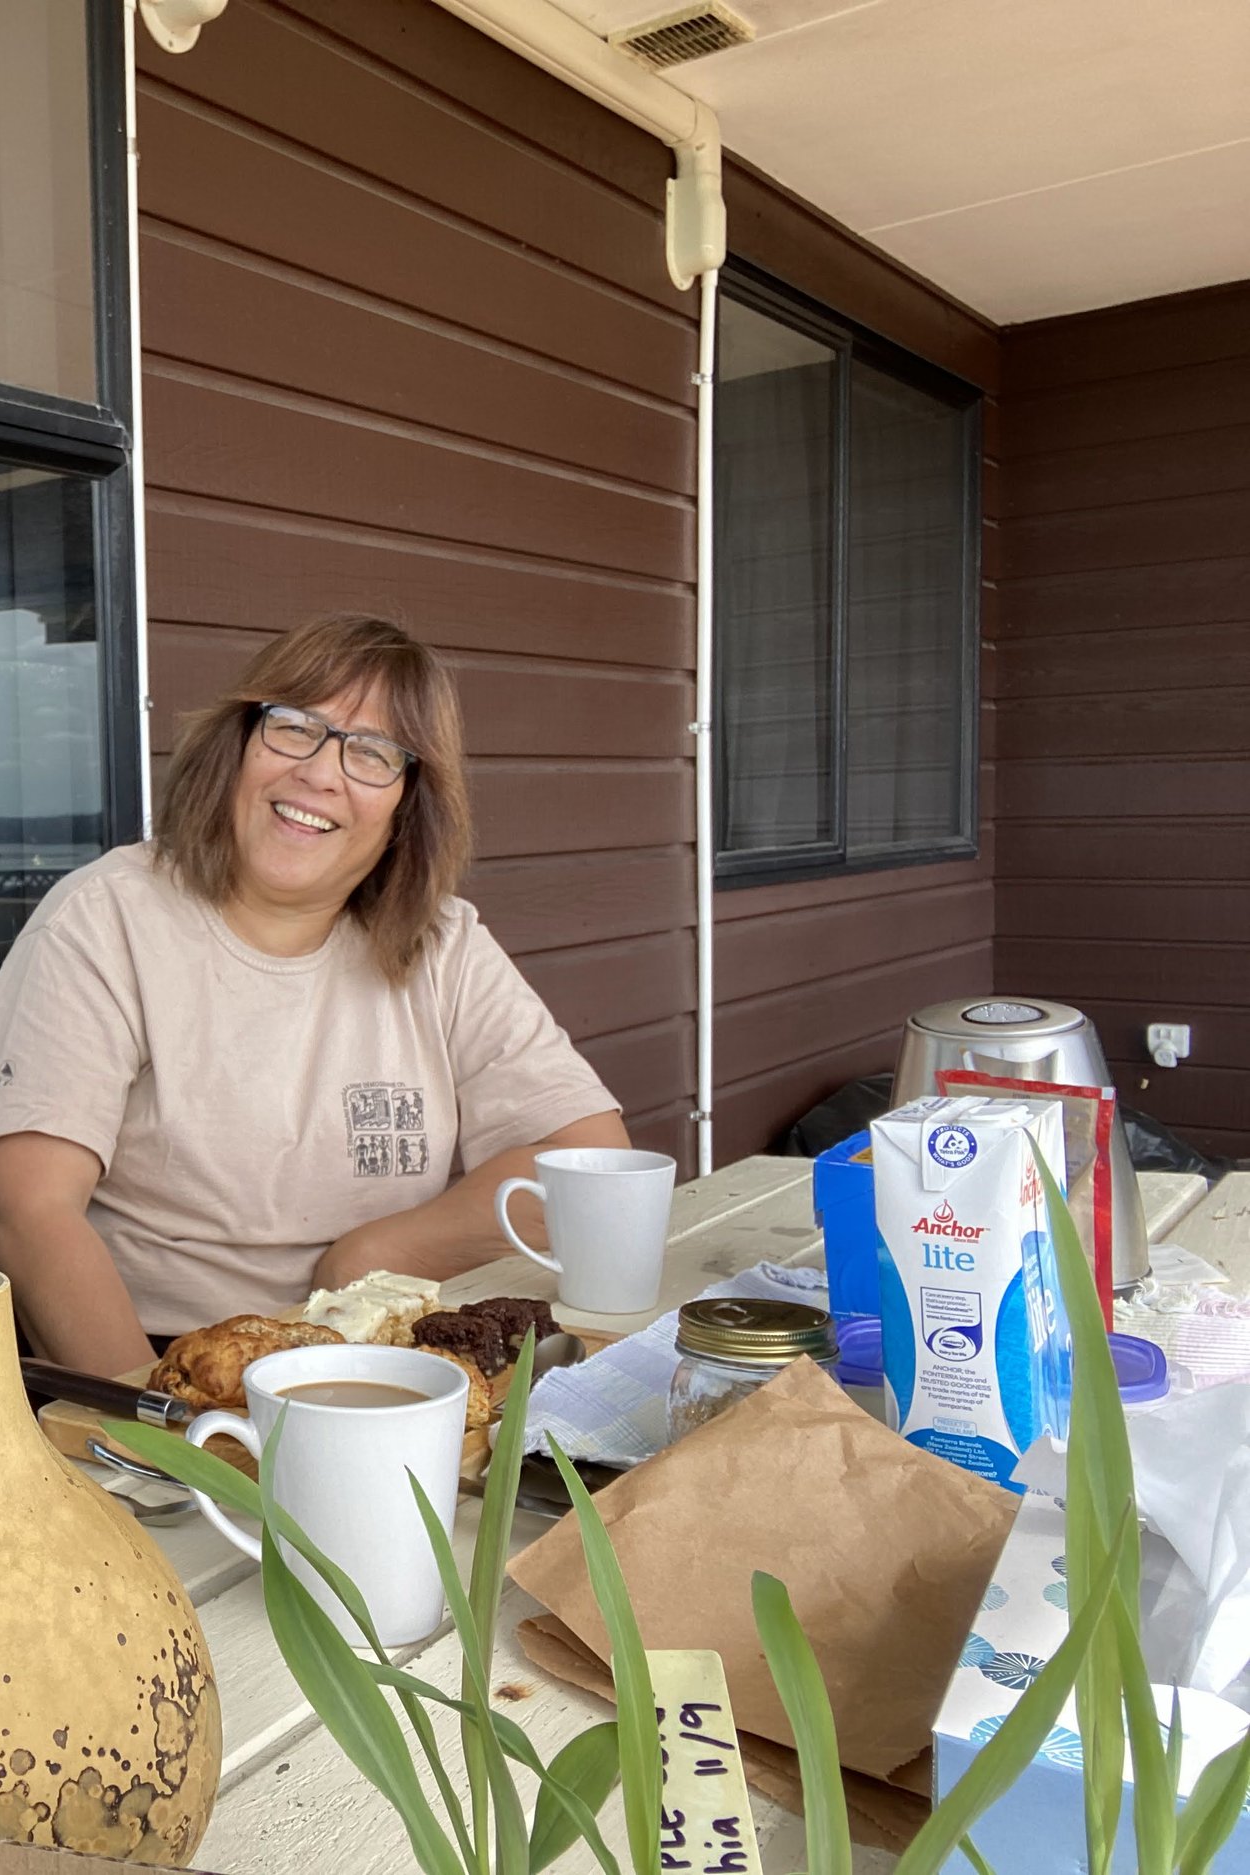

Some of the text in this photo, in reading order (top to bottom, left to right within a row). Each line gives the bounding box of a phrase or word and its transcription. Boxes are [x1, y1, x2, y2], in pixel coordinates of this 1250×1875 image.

[936, 1126, 970, 1136] PROTECTS
[933, 1152, 974, 1167] WHAT'S GOOD
[910, 1217, 985, 1239] Anchor
[922, 1243, 975, 1272] lite
[1027, 1286, 1057, 1354] lite
[922, 1369, 959, 1380] FONTERRA
[919, 1376, 992, 1391] TRUSTED GOODNESS
